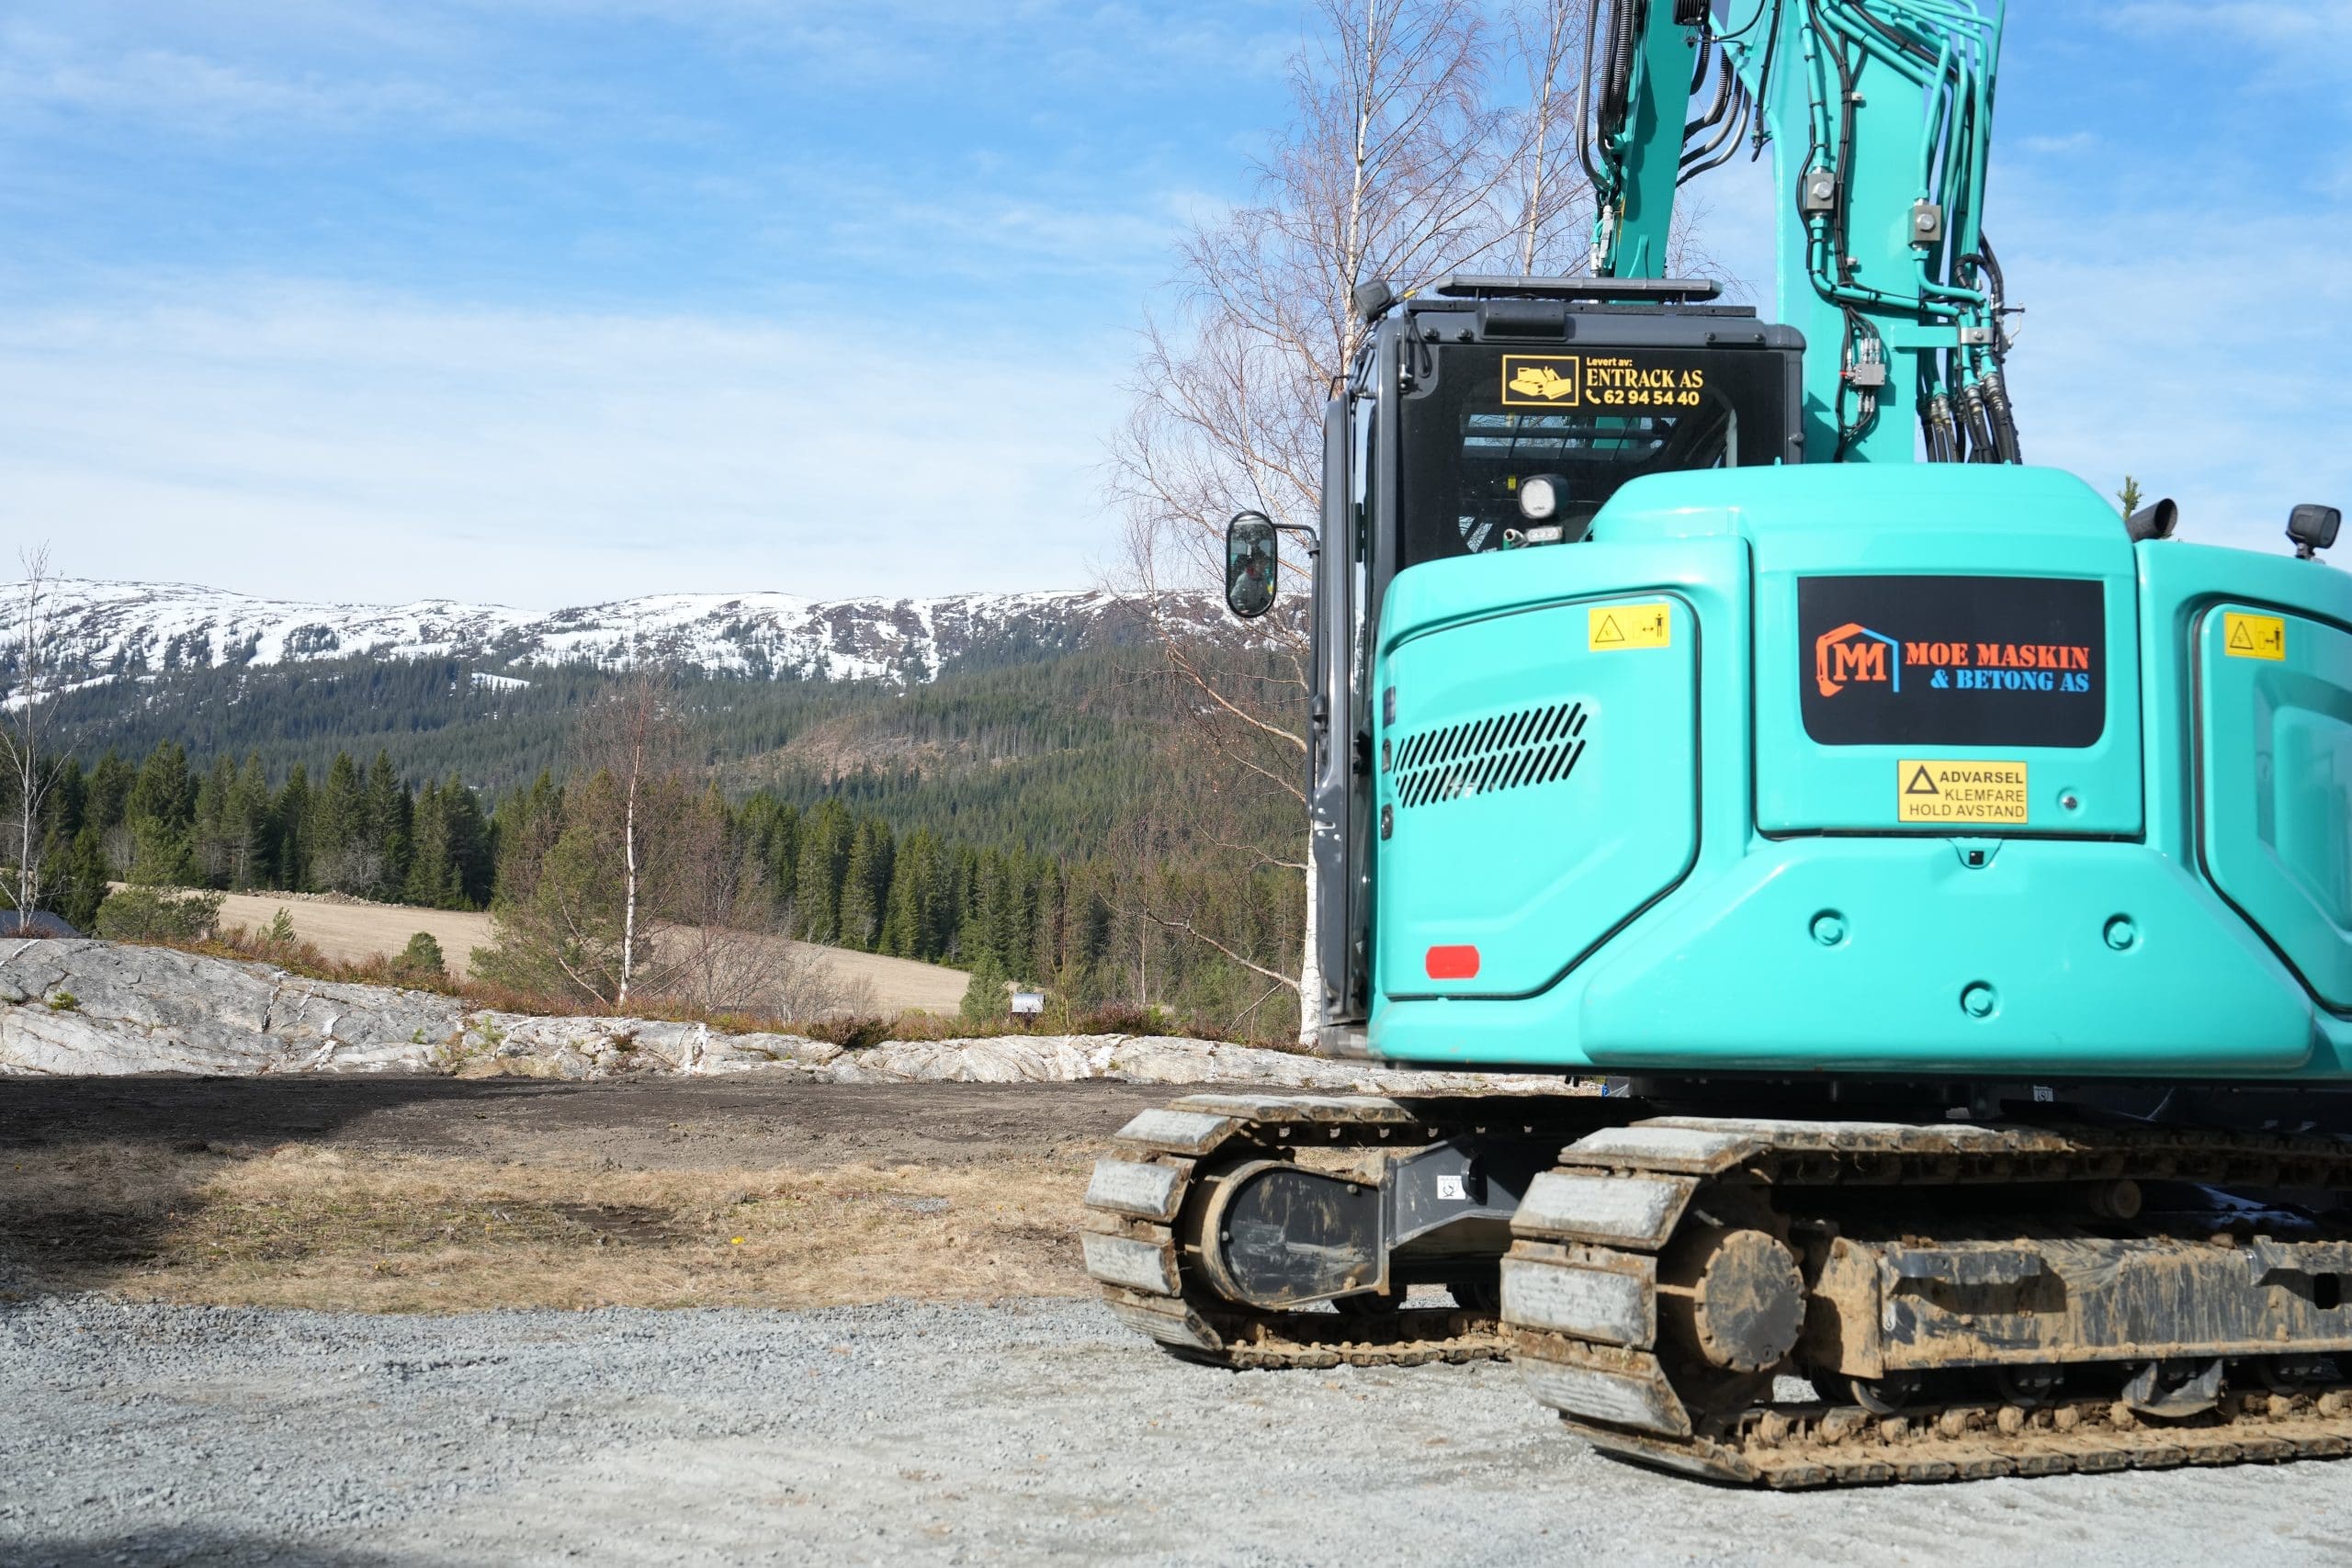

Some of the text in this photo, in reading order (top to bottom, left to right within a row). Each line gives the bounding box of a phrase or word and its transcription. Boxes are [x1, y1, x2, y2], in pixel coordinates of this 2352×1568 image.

[1587, 357, 1633, 367] Levert av:
[1587, 368, 1704, 389] ENTRACK AS
[1604, 390, 1700, 405] 62 94 54 40
[1905, 643, 2089, 670] MOE MASKIN
[1930, 669, 2089, 692] & BETONG AS
[1939, 771, 2023, 784] ADVARSEL
[1945, 789, 2024, 802] KLEMFARE
[1909, 804, 2025, 818] HOLD AVSTAND
